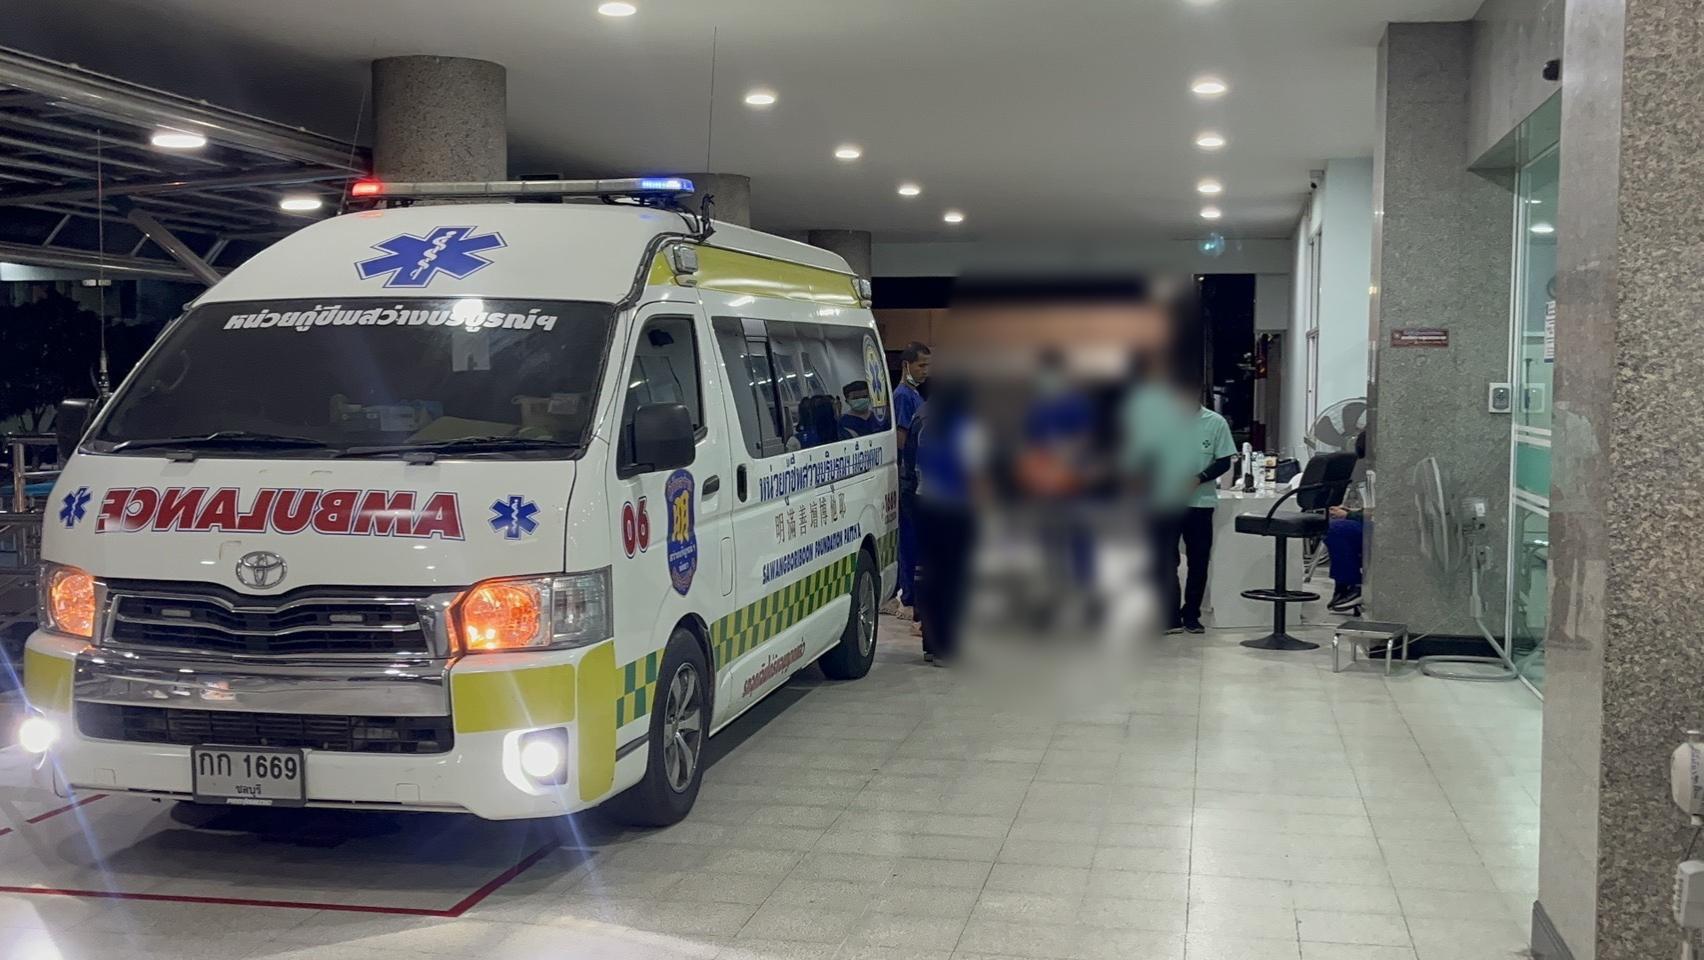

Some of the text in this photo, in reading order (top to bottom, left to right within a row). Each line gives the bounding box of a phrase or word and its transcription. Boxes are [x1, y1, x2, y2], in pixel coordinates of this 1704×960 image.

[224, 306, 557, 333] หน่วยกู้ชีพสว่างบรบูรณ์ฯ
[622, 496, 650, 559] 06
[199, 753, 297, 781] กก 1669
[235, 783, 262, 798] ชลบุรี
